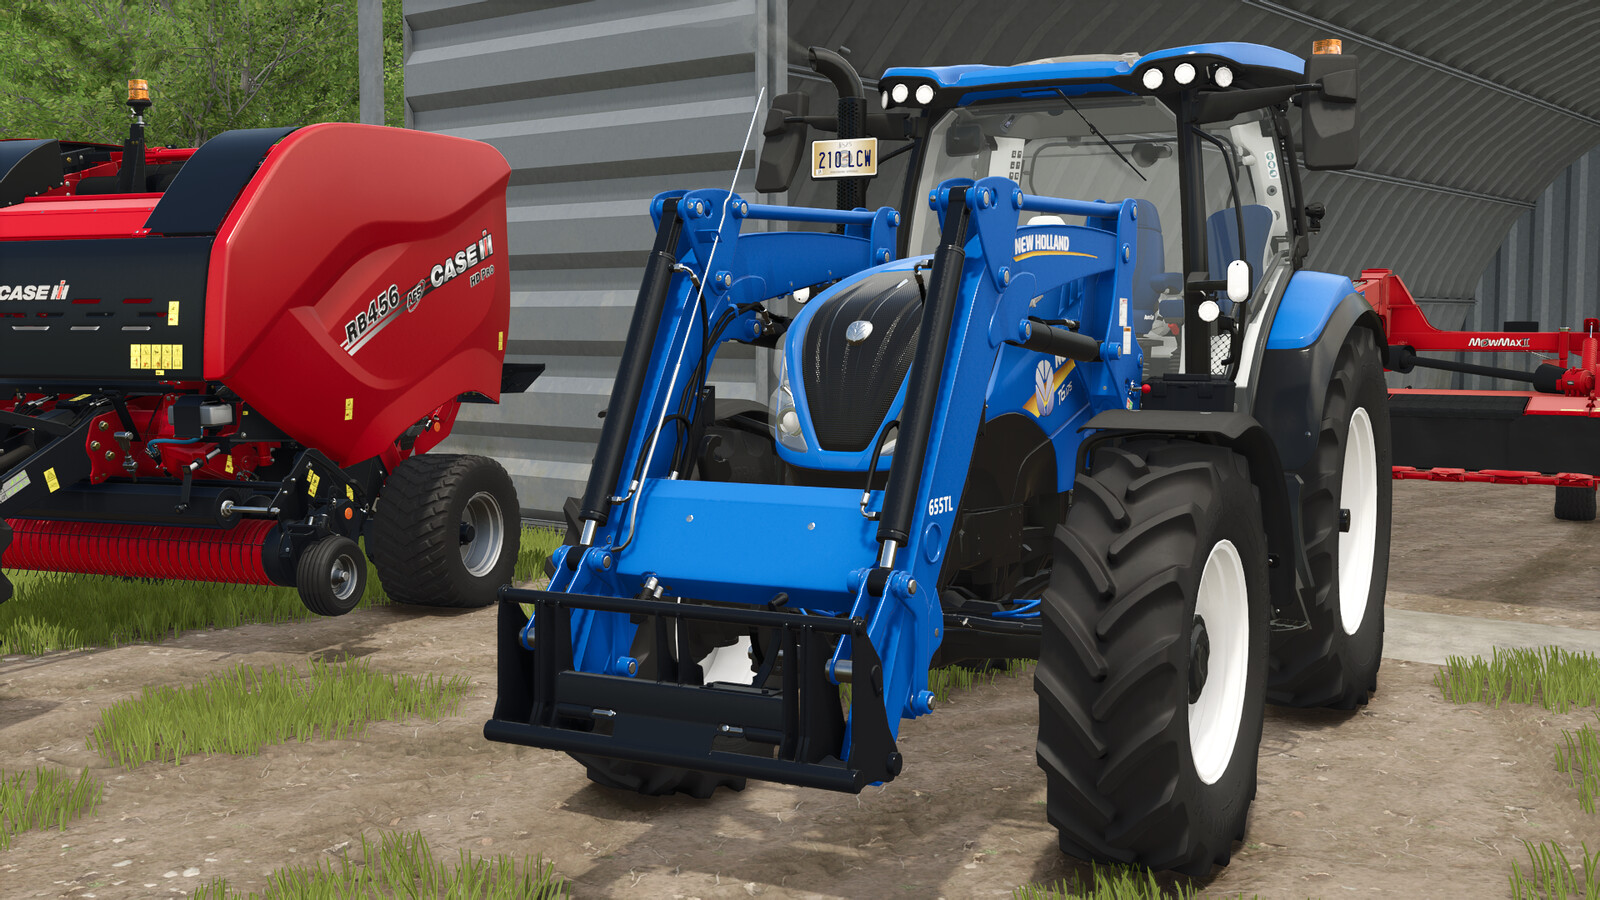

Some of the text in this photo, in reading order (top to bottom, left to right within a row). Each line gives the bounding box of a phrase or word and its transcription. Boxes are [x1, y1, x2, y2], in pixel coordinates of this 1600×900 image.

[819, 150, 871, 169] 210 LCW
[1014, 233, 1070, 256] NEW HOLLAND
[430, 242, 478, 288] CASE
[469, 272, 480, 288] HD
[0, 285, 50, 300] CASE
[344, 283, 400, 346] RB456
[929, 496, 953, 516] 655TL
